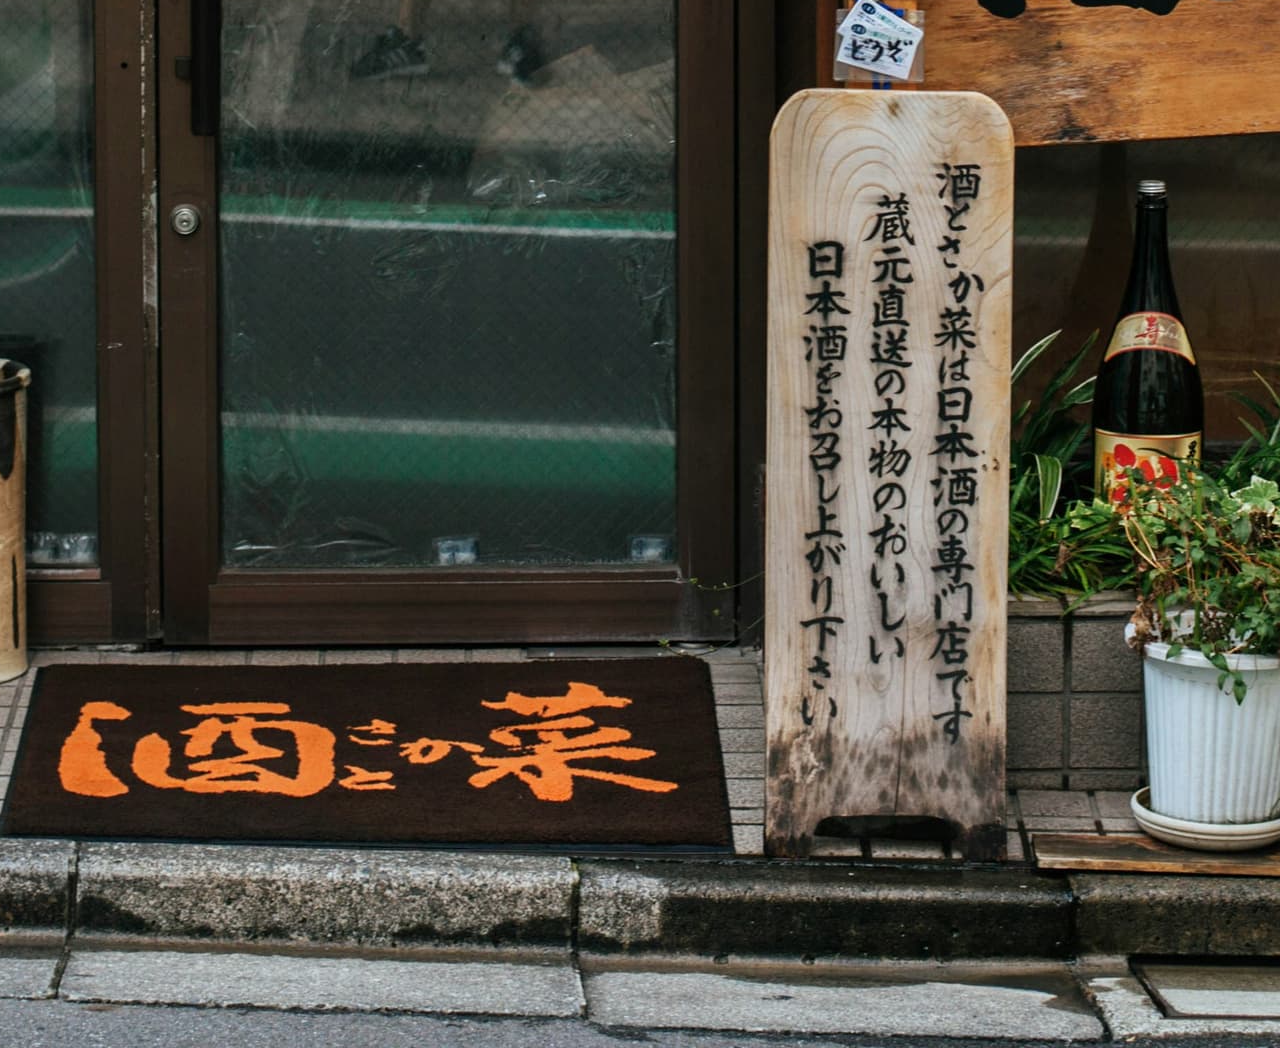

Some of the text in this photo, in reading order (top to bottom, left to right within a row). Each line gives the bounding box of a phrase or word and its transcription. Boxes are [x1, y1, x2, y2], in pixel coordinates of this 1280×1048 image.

[851, 38, 914, 63] どうぞ
[799, 239, 852, 727] 日本酒をお召し上がり下さい
[863, 191, 916, 664] 蔵元直送の本物のおいしい
